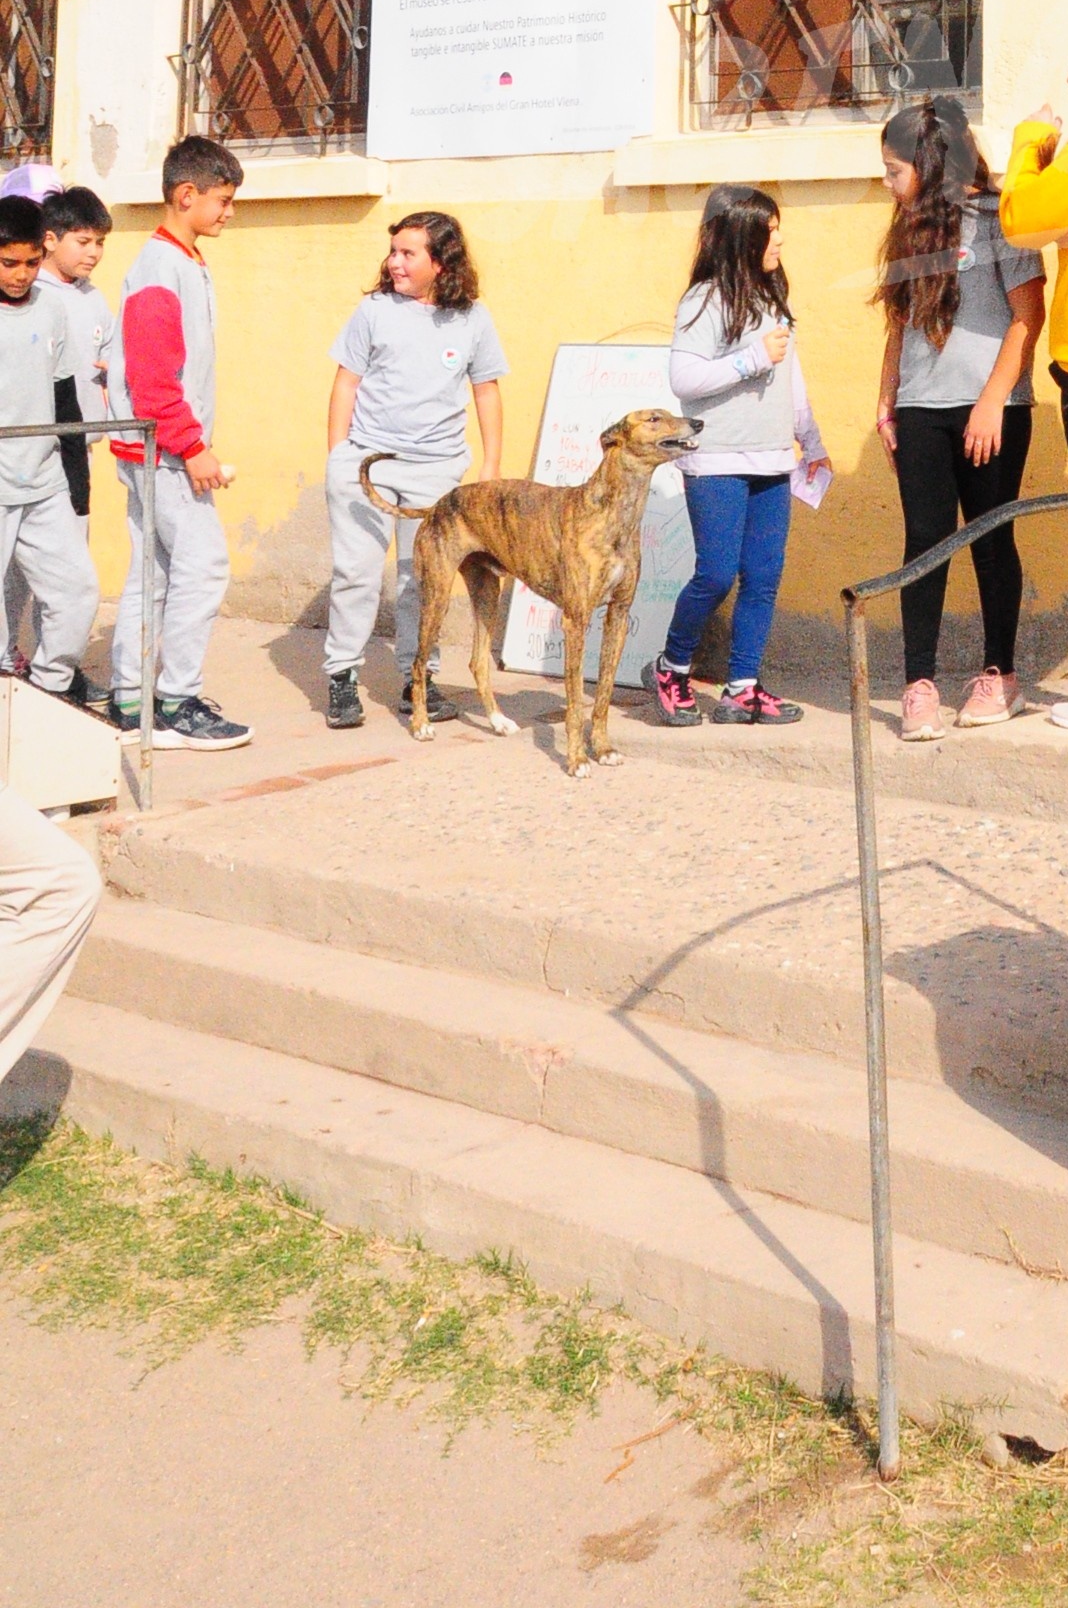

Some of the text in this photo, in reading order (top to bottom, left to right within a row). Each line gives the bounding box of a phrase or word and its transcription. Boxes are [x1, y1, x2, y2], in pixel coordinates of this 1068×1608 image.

[449, 26, 453, 34] a
[455, 20, 479, 33] cuidar
[482, 18, 514, 30] Nuestro
[516, 13, 565, 27] Patrimonio
[410, 43, 441, 58] tangible
[451, 39, 489, 54] intangible
[492, 35, 526, 49] SUMATE
[530, 37, 535, 45] a
[538, 33, 572, 45] nuestra
[449, 103, 464, 113] Civil
[466, 102, 494, 114] Amigos
[495, 100, 507, 110] del
[509, 99, 529, 109] Gran
[531, 98, 554, 108] Hotel
